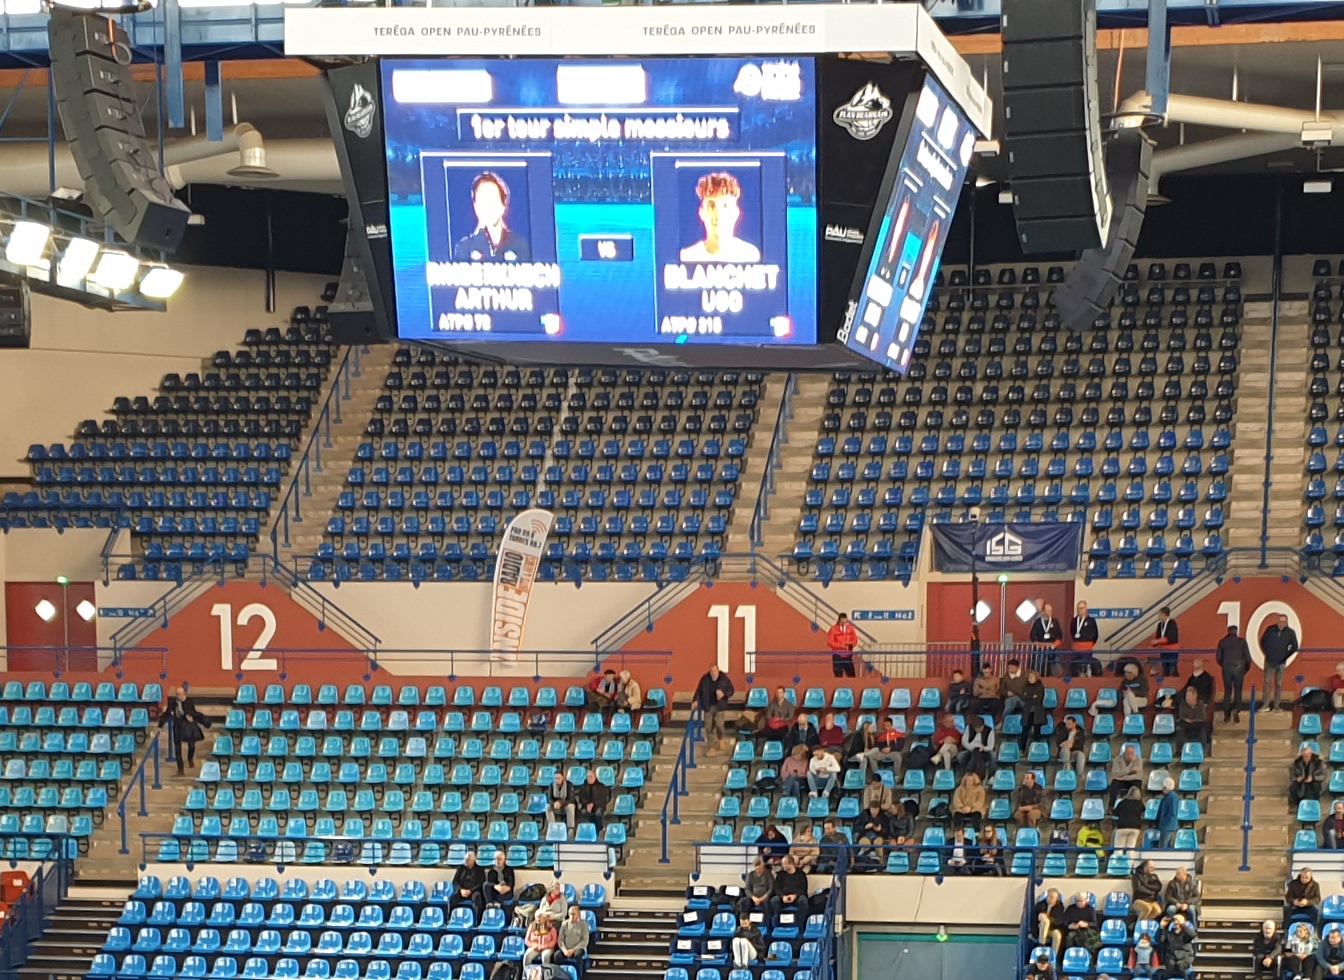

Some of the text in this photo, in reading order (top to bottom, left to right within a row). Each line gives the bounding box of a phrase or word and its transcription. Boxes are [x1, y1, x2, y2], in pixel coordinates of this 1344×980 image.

[420, 26, 452, 37] OPEN
[690, 25, 723, 36] OPEN
[471, 113, 505, 139] 1er
[507, 113, 552, 139] tour
[554, 112, 621, 143] simple
[825, 223, 847, 238] PAU
[455, 287, 533, 311] ARTHUR
[499, 551, 524, 587] RADIO
[210, 602, 279, 671] 12
[707, 603, 757, 673] 11
[1216, 599, 1303, 673] 10
